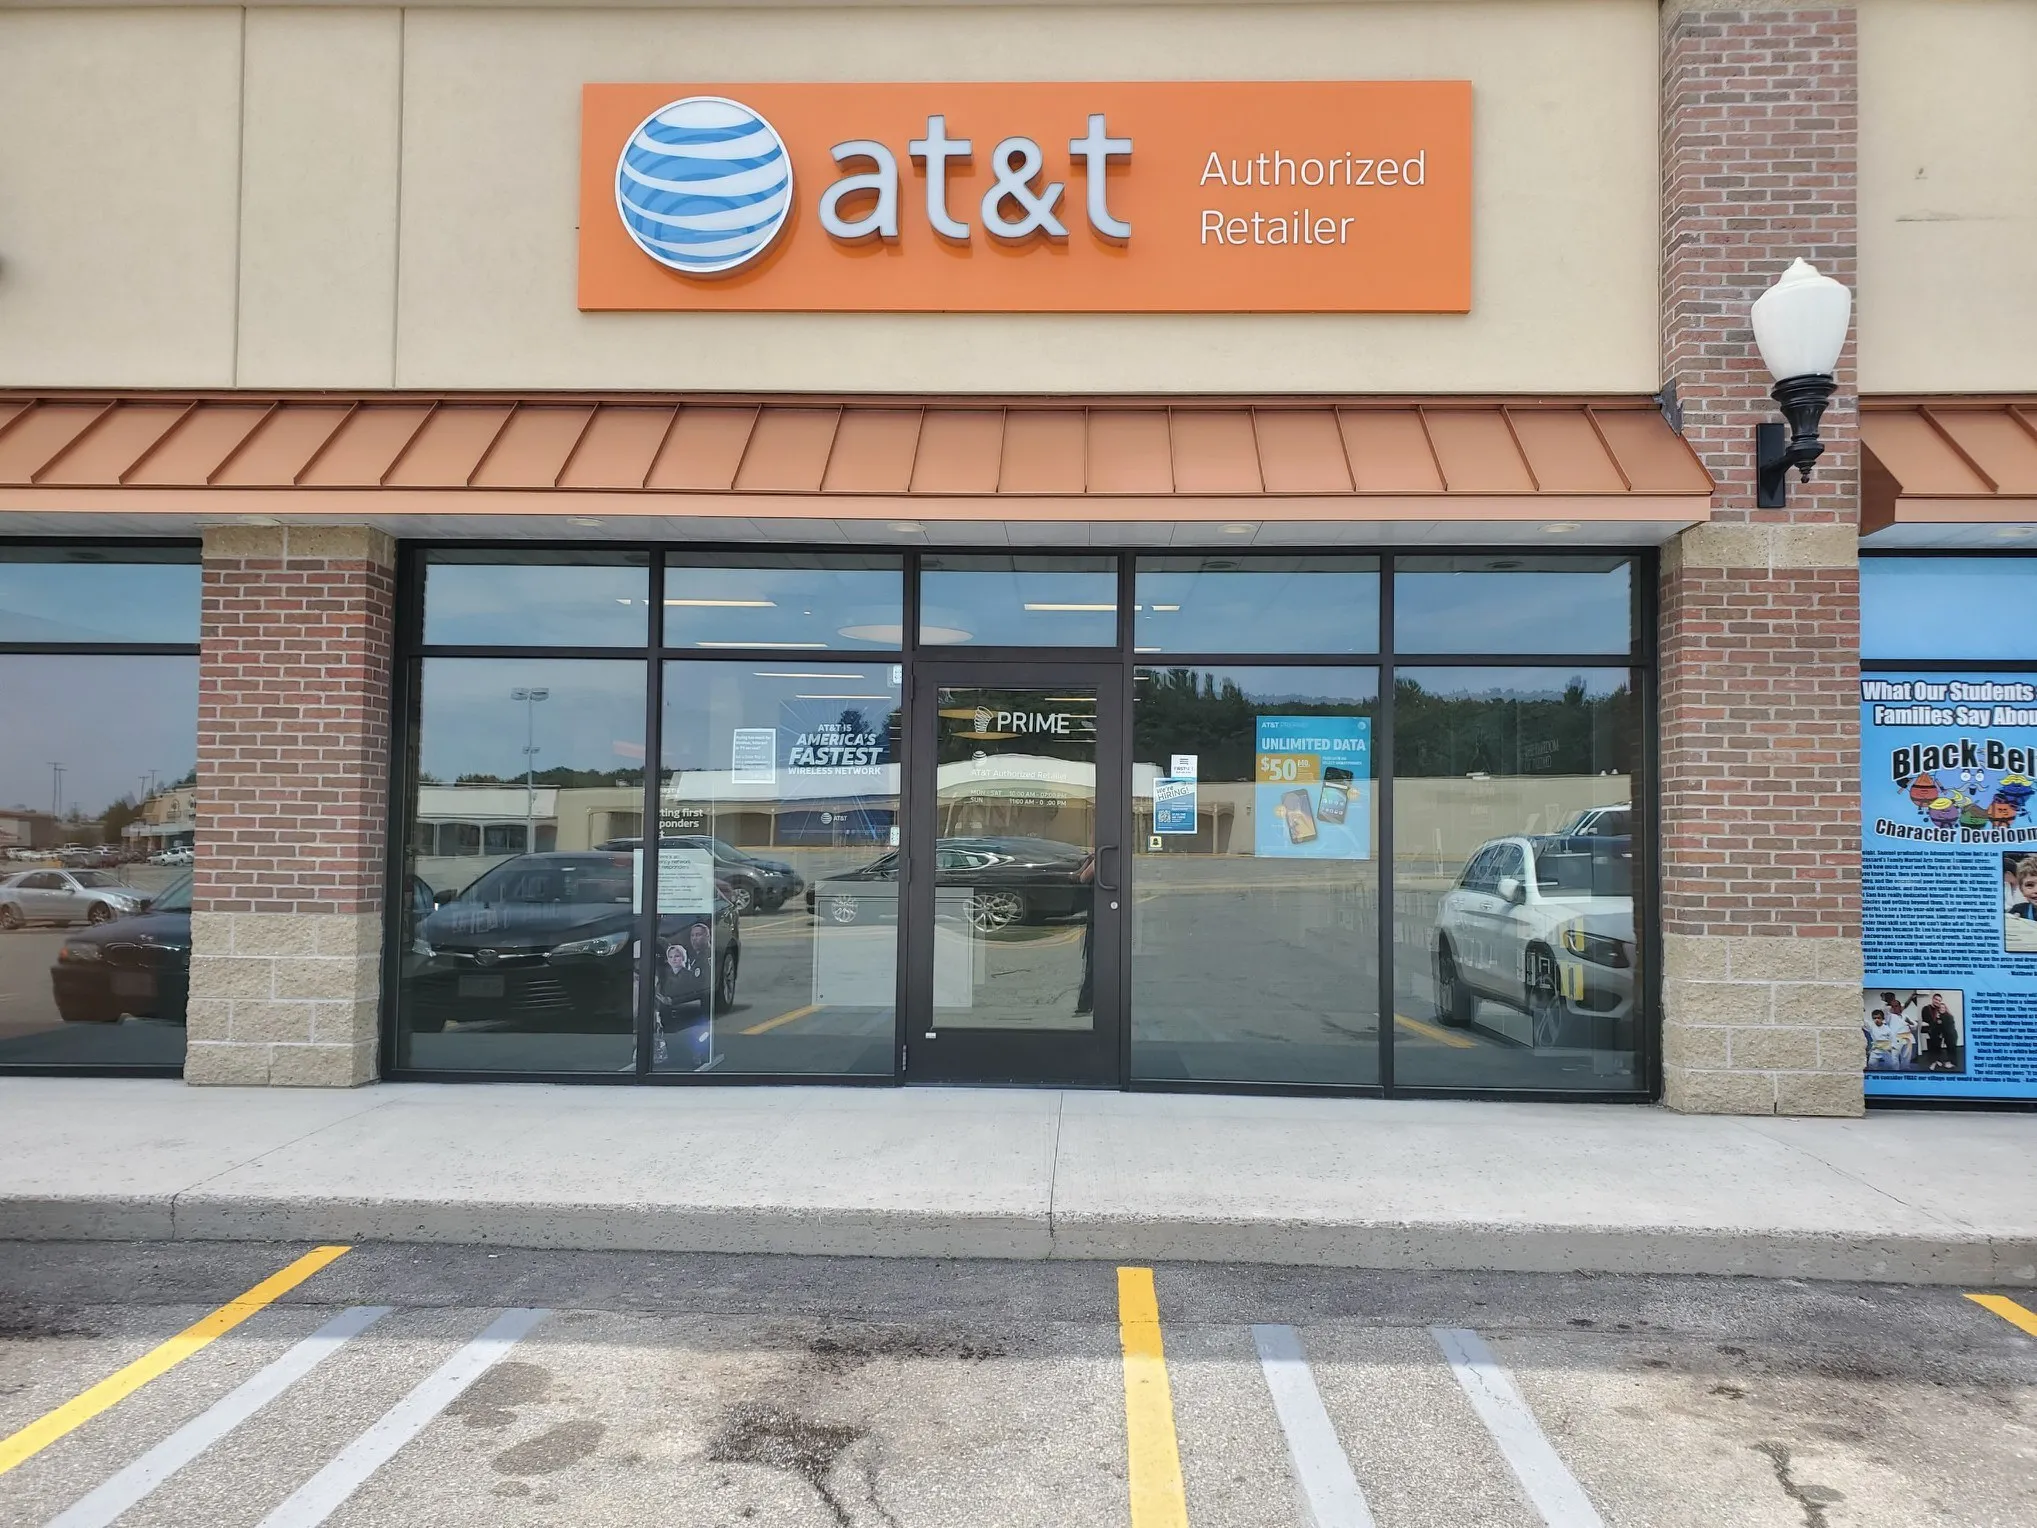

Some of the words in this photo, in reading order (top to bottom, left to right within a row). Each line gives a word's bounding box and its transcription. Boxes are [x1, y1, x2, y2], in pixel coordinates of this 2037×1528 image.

[1199, 149, 1426, 186] Authorized
[818, 113, 1133, 244] at&t
[1200, 208, 1355, 245] Retailer
[1861, 681, 1912, 701] What
[1914, 681, 1947, 701] Our
[1949, 681, 2034, 702] Students
[996, 711, 1070, 734] PRIME
[1874, 705, 1953, 726] Families
[1955, 706, 1991, 727] Say
[818, 724, 841, 732] AT&T
[843, 724, 852, 732] IS
[1261, 721, 1280, 729] AT&T
[796, 733, 877, 746] AMERICA'S
[1261, 738, 1330, 750] UNLIMITED
[1334, 738, 1366, 751] DATA
[788, 747, 883, 766] FASTEST
[1893, 738, 1979, 781] Black
[1986, 738, 2037, 778] Bel
[788, 767, 833, 775] WIRELESS
[835, 767, 881, 775] NETWORK
[993, 769, 1035, 778] Authorized
[1261, 756, 1297, 781] $50
[1156, 785, 1174, 794] We're
[1157, 786, 1190, 801] HIRING!
[660, 808, 681, 819] ting
[682, 808, 703, 817] first
[659, 819, 700, 830] ponders
[1875, 819, 1957, 843] Character
